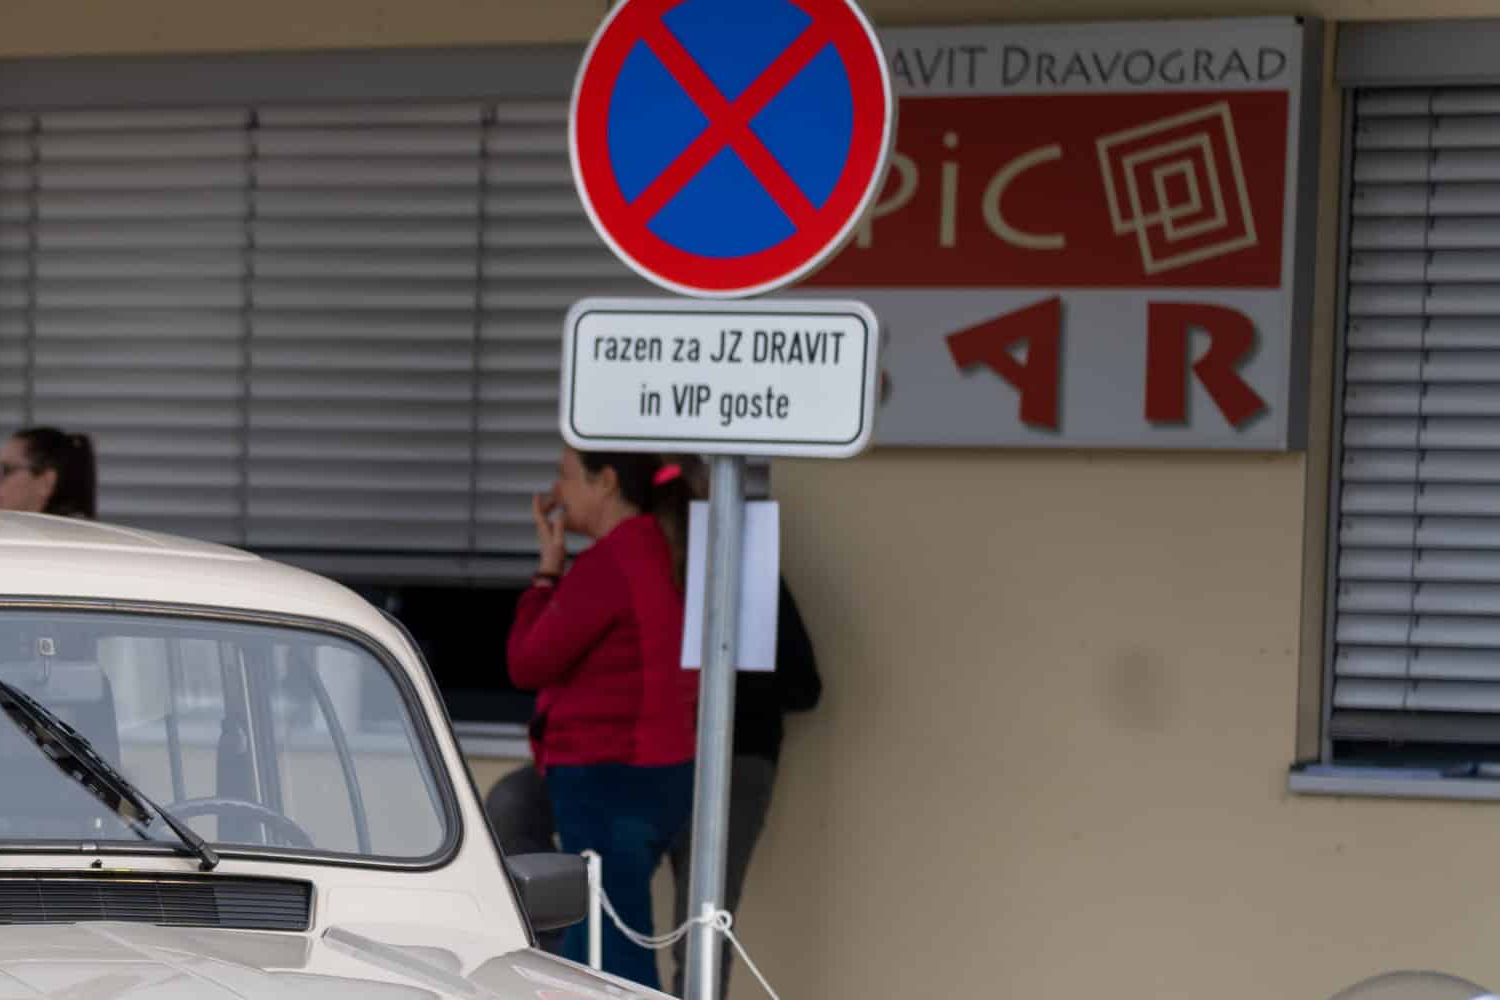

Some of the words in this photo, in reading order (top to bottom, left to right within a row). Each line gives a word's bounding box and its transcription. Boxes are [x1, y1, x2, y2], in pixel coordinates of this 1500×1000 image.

[891, 45, 987, 87] AVIT
[594, 335, 662, 361] razen
[672, 337, 700, 361] za
[710, 331, 743, 363] JZ
[753, 331, 845, 365] DRAVIT
[640, 384, 661, 416] in
[672, 385, 711, 417] VIP
[719, 386, 790, 426] goste
